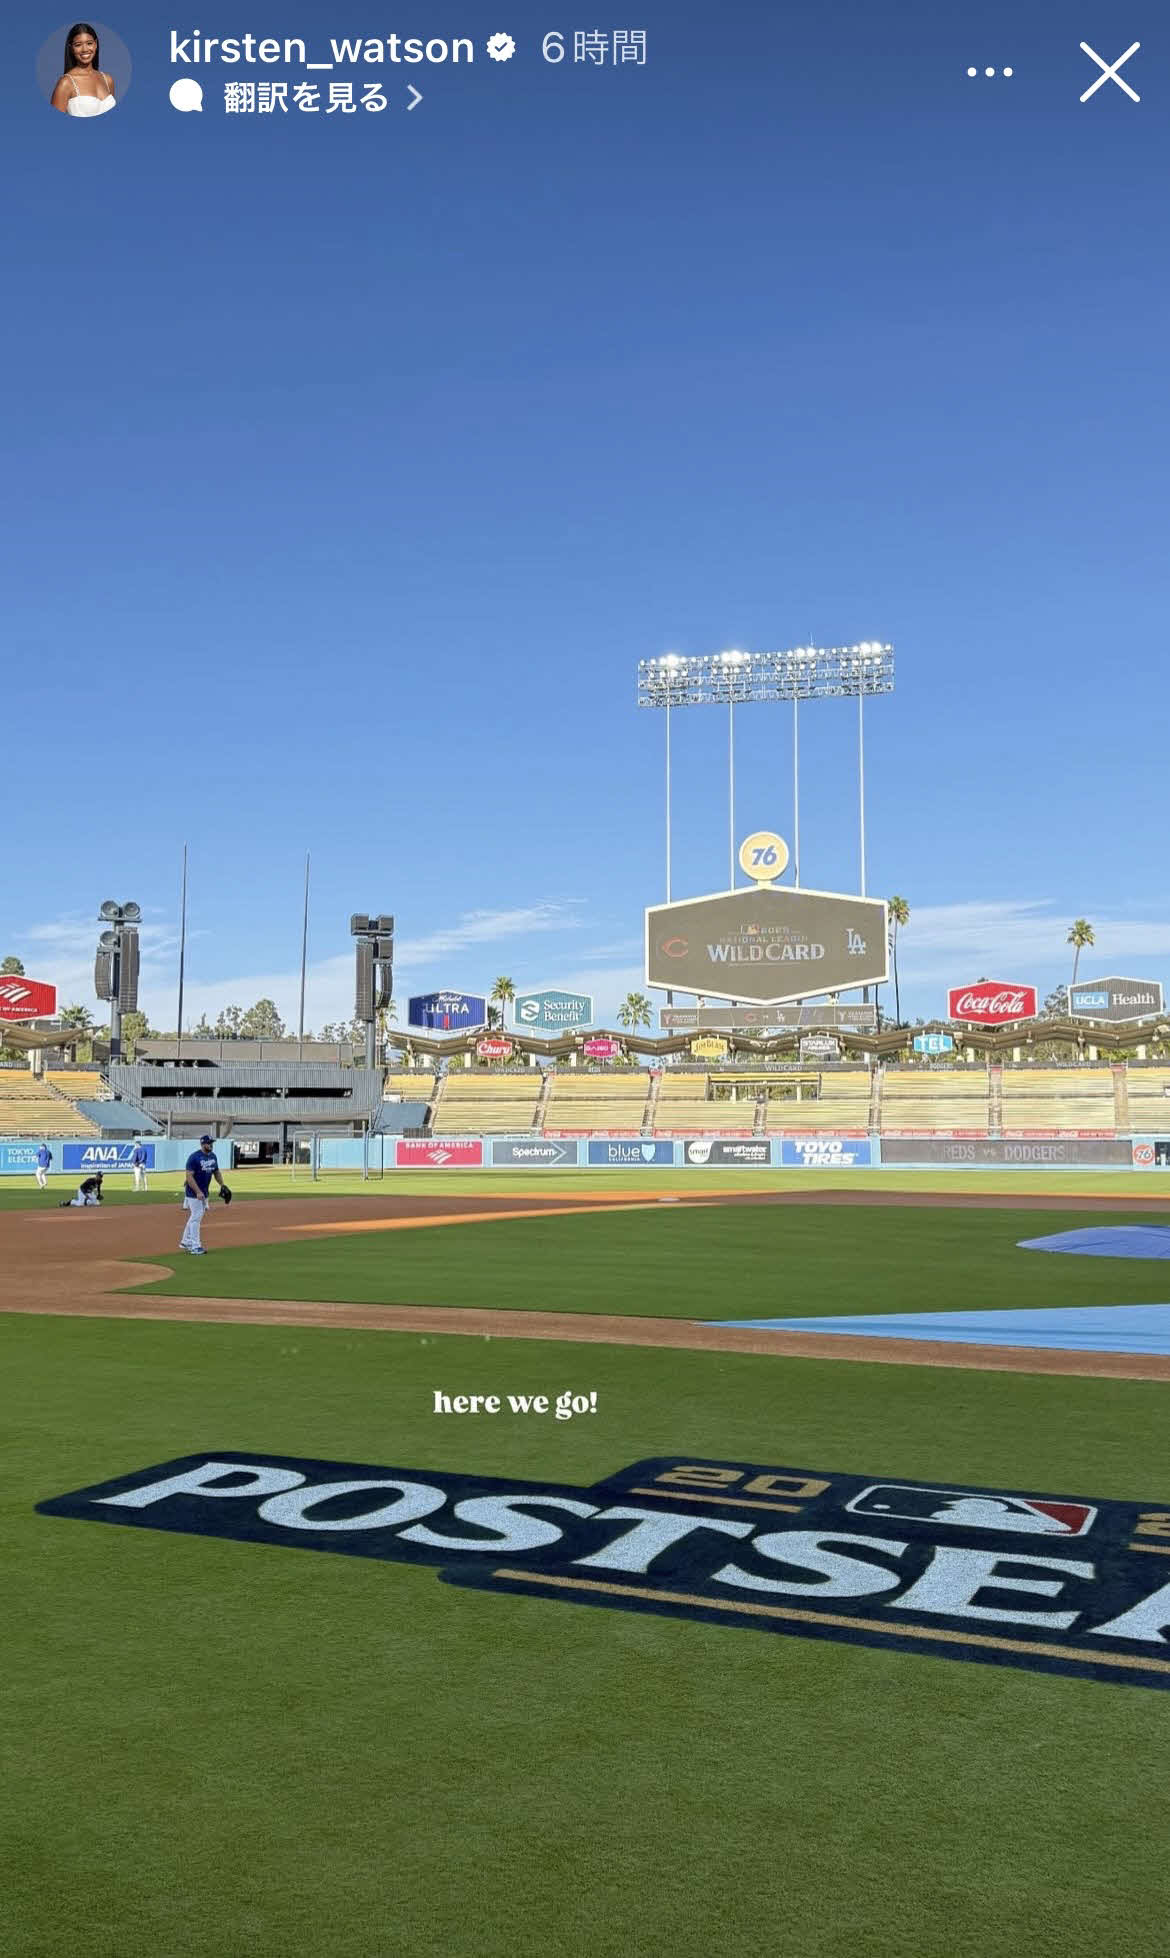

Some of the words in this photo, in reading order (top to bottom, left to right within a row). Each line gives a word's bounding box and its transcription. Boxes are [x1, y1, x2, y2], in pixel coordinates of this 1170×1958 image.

[752, 845, 777, 866] 76
[543, 1000, 584, 1012] Security
[956, 991, 1025, 1015] Coca-Cola
[1075, 993, 1105, 1005] UCLA
[1112, 993, 1155, 1006] Health
[425, 1003, 469, 1014] ULTRA
[543, 1011, 581, 1022] Benefit
[921, 1037, 946, 1049] TEL
[82, 1147, 118, 1160] ANA
[512, 1147, 555, 1158] Spectrum
[609, 1143, 640, 1156] blue
[795, 1141, 842, 1153] TOYO
[944, 1145, 975, 1160] REDS
[1004, 1145, 1065, 1160] DODGERS
[803, 1152, 855, 1165] TIRES
[654, 1465, 832, 1498] 20
